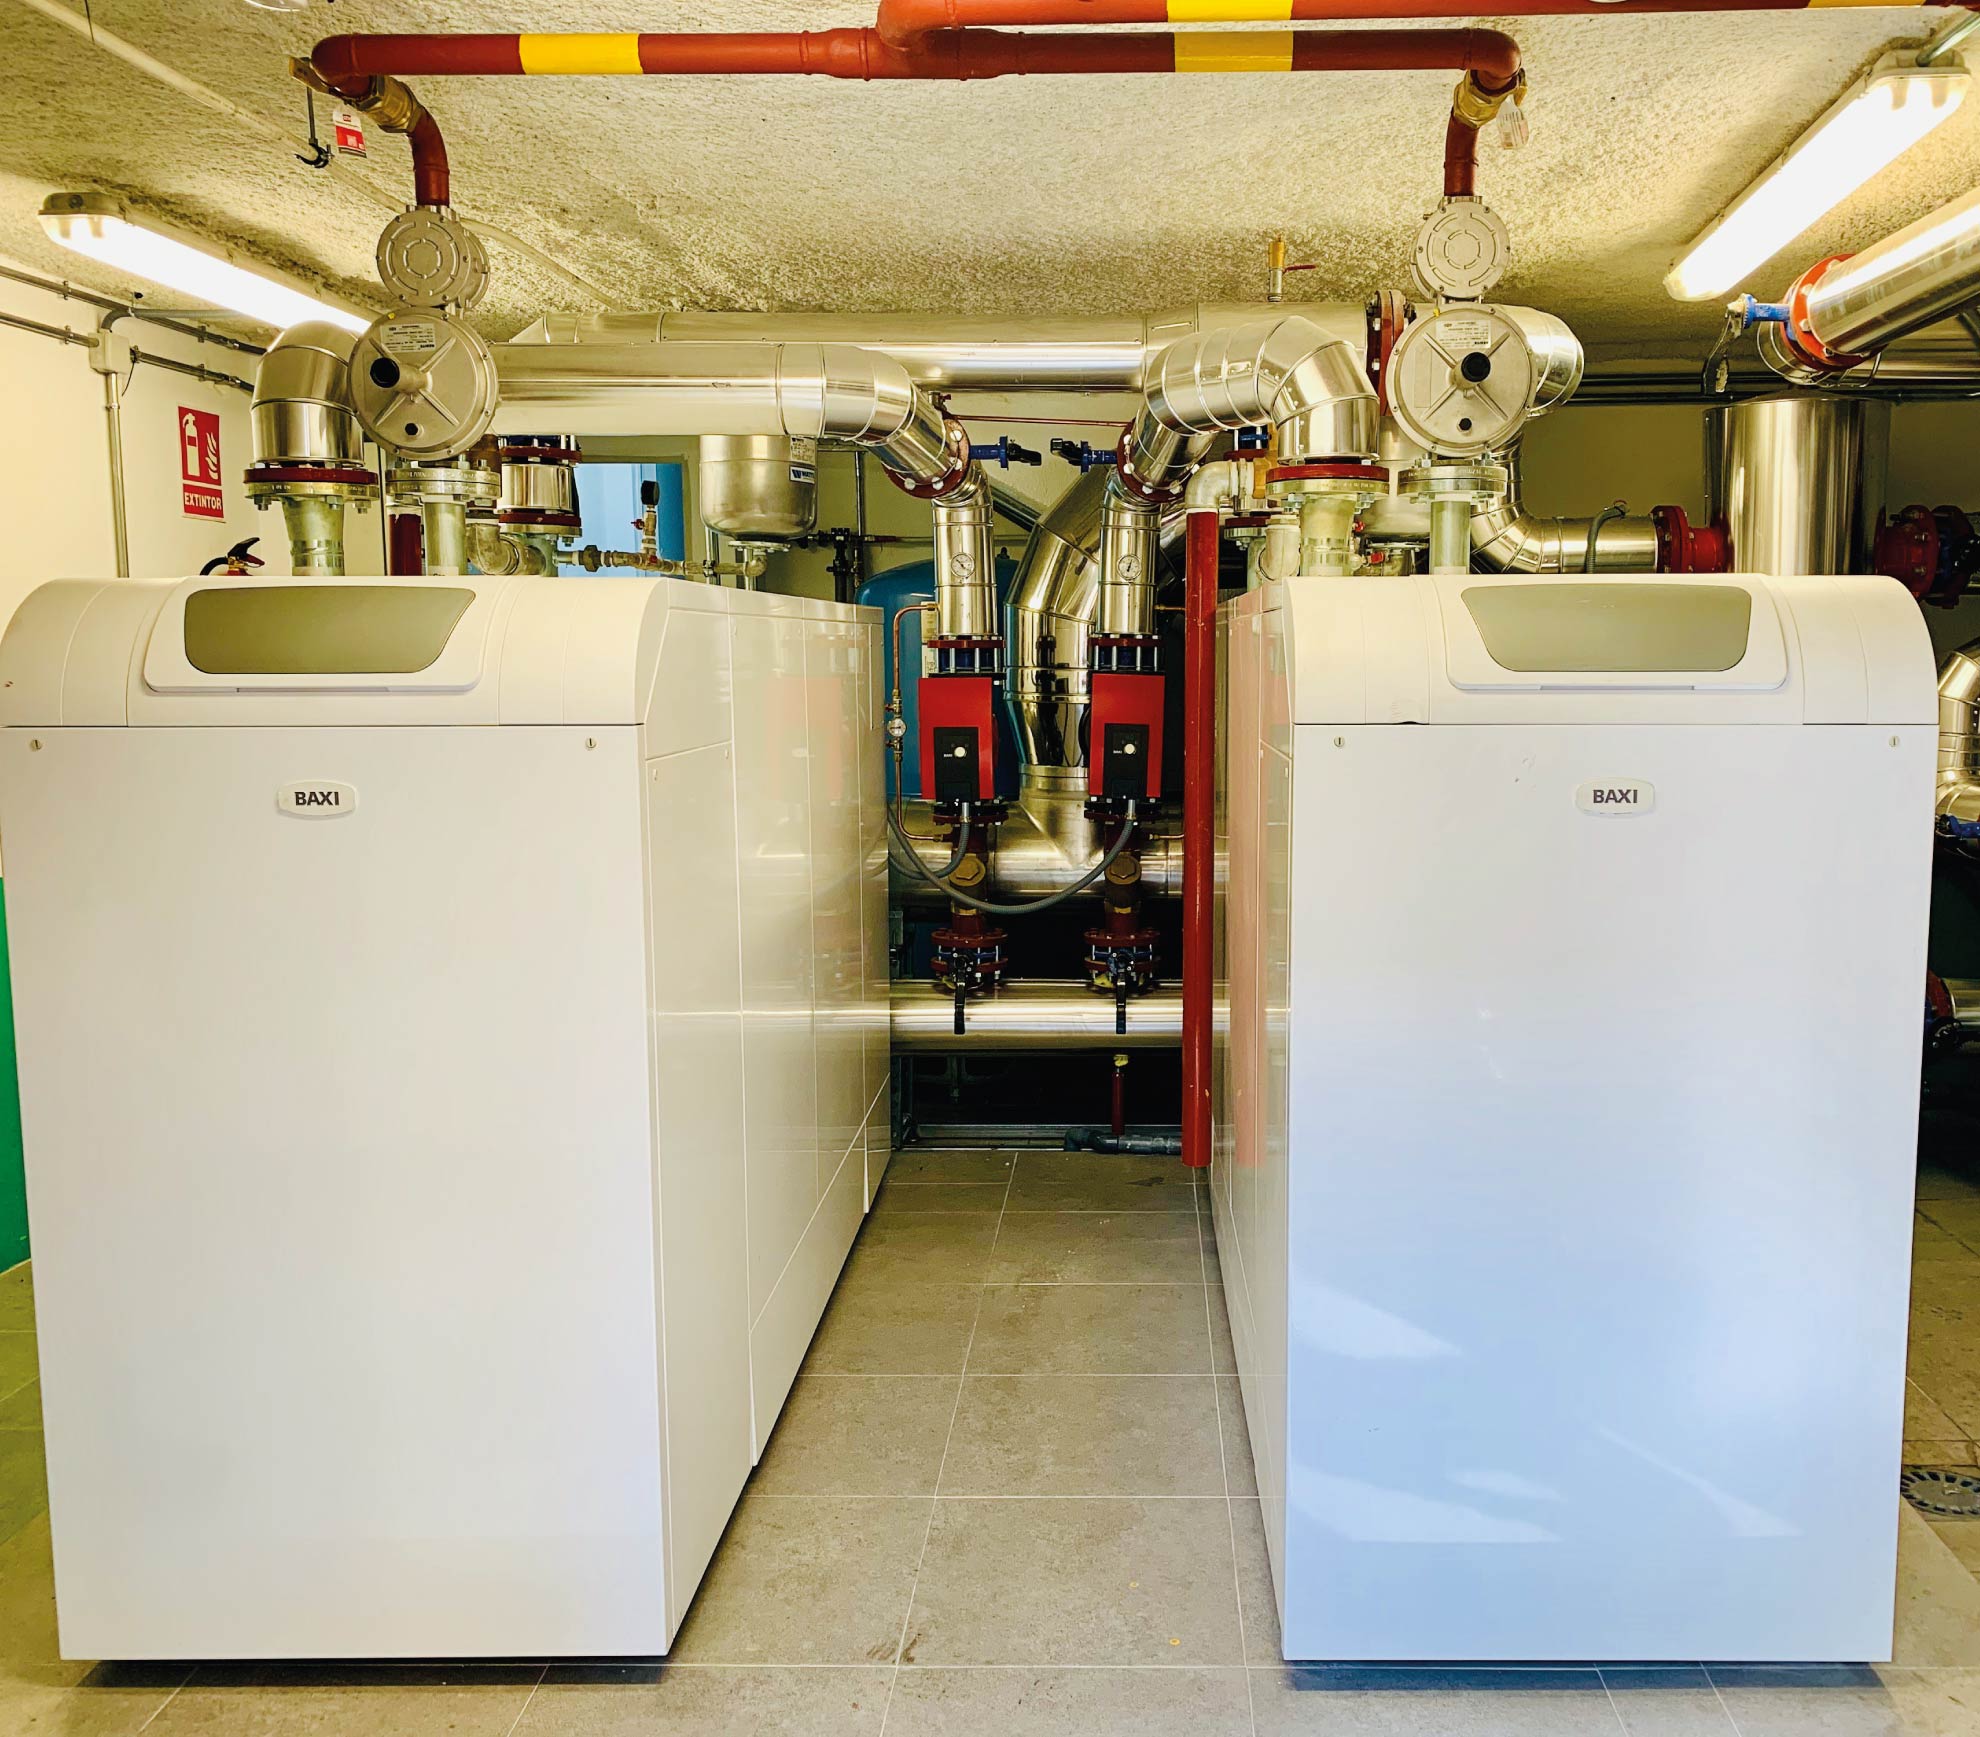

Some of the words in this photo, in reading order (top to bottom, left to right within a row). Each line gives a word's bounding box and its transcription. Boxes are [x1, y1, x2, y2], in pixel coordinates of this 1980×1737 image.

[184, 492, 222, 510] EXTINTOR
[294, 791, 340, 806] BAXI
[1592, 789, 1638, 804] BAXI
